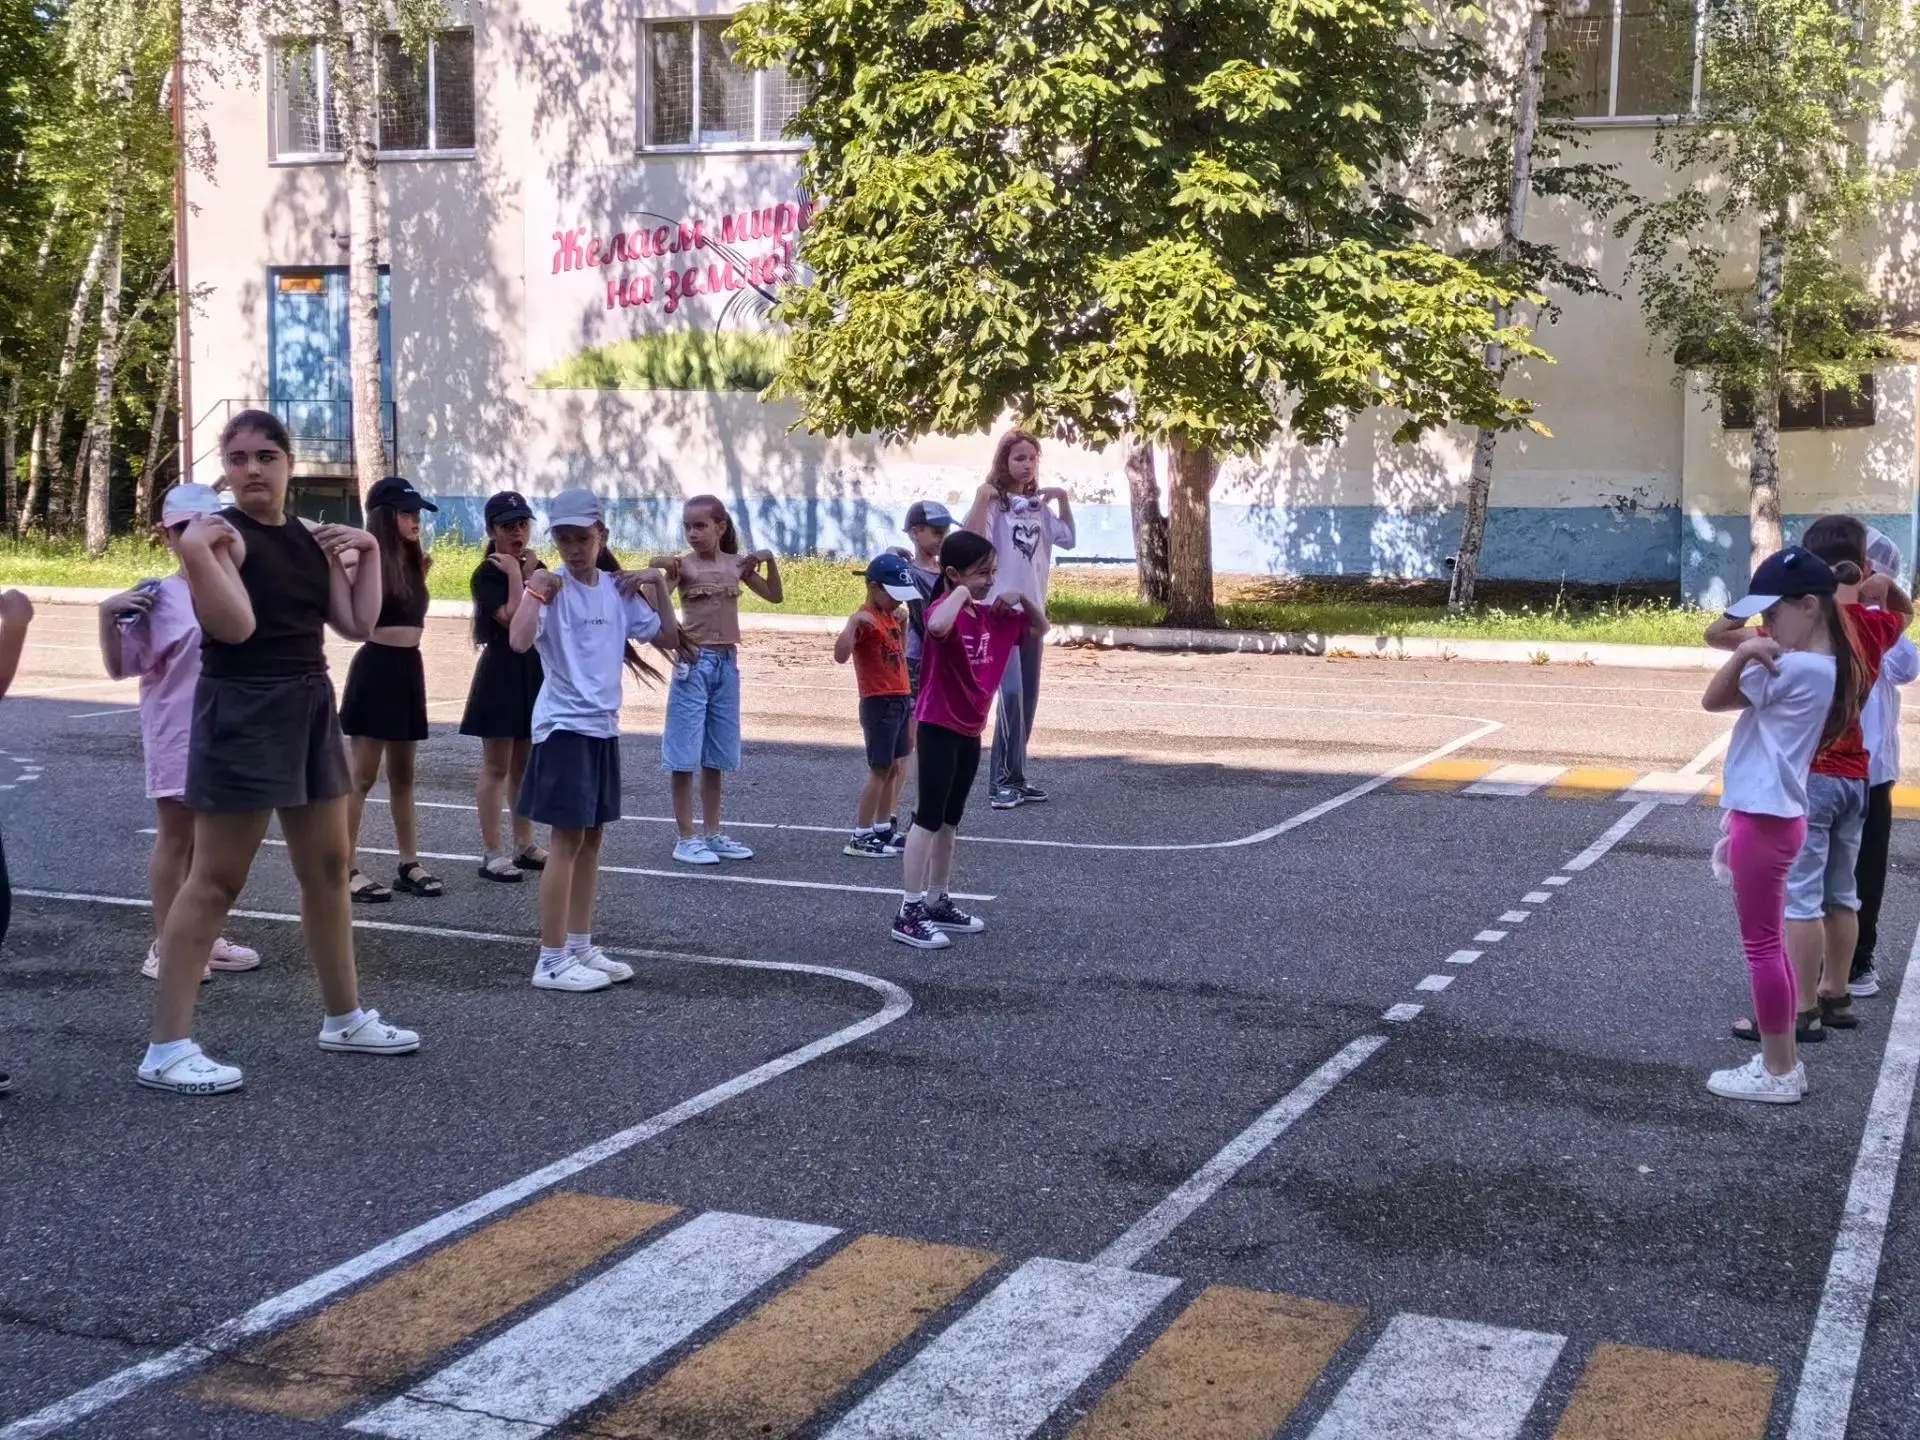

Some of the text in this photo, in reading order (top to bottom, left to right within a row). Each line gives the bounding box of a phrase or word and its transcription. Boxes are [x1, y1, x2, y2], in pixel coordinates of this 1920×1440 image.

[551, 219, 706, 275] Желаем
[606, 240, 793, 314] на земле!
[176, 1081, 216, 1093] crocs
